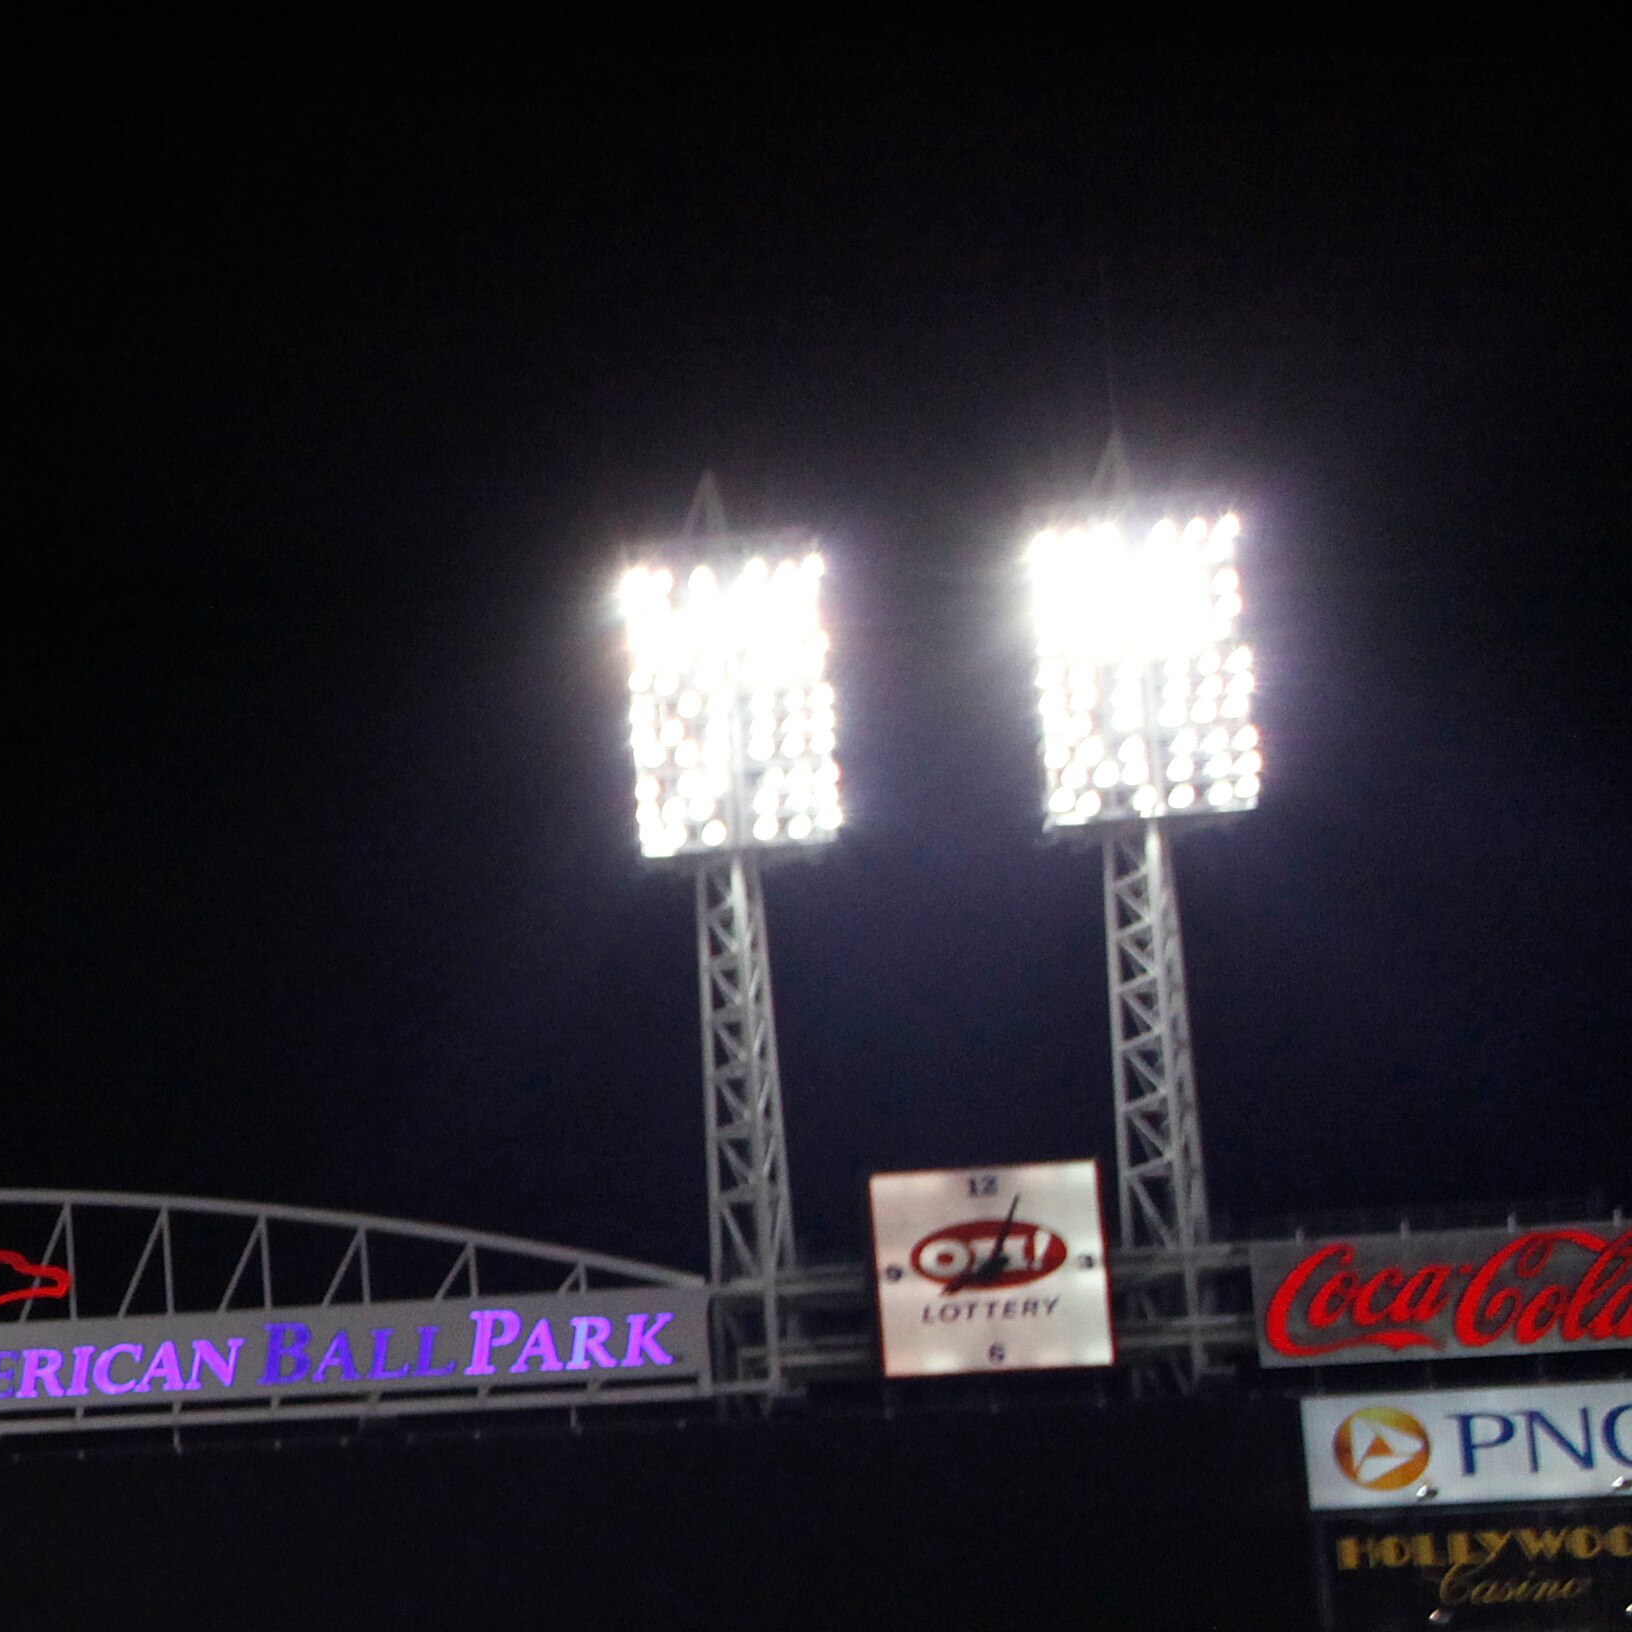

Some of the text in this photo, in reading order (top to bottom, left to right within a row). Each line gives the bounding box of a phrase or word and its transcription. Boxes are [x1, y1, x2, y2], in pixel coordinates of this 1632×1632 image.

[969, 1176, 997, 1197] 12
[922, 1296, 1059, 1325] LOTTERY
[256, 1321, 456, 1386] BALL
[463, 1308, 673, 1376] PARK
[989, 1344, 1005, 1363] 6
[1439, 1562, 1591, 1605] Casino
